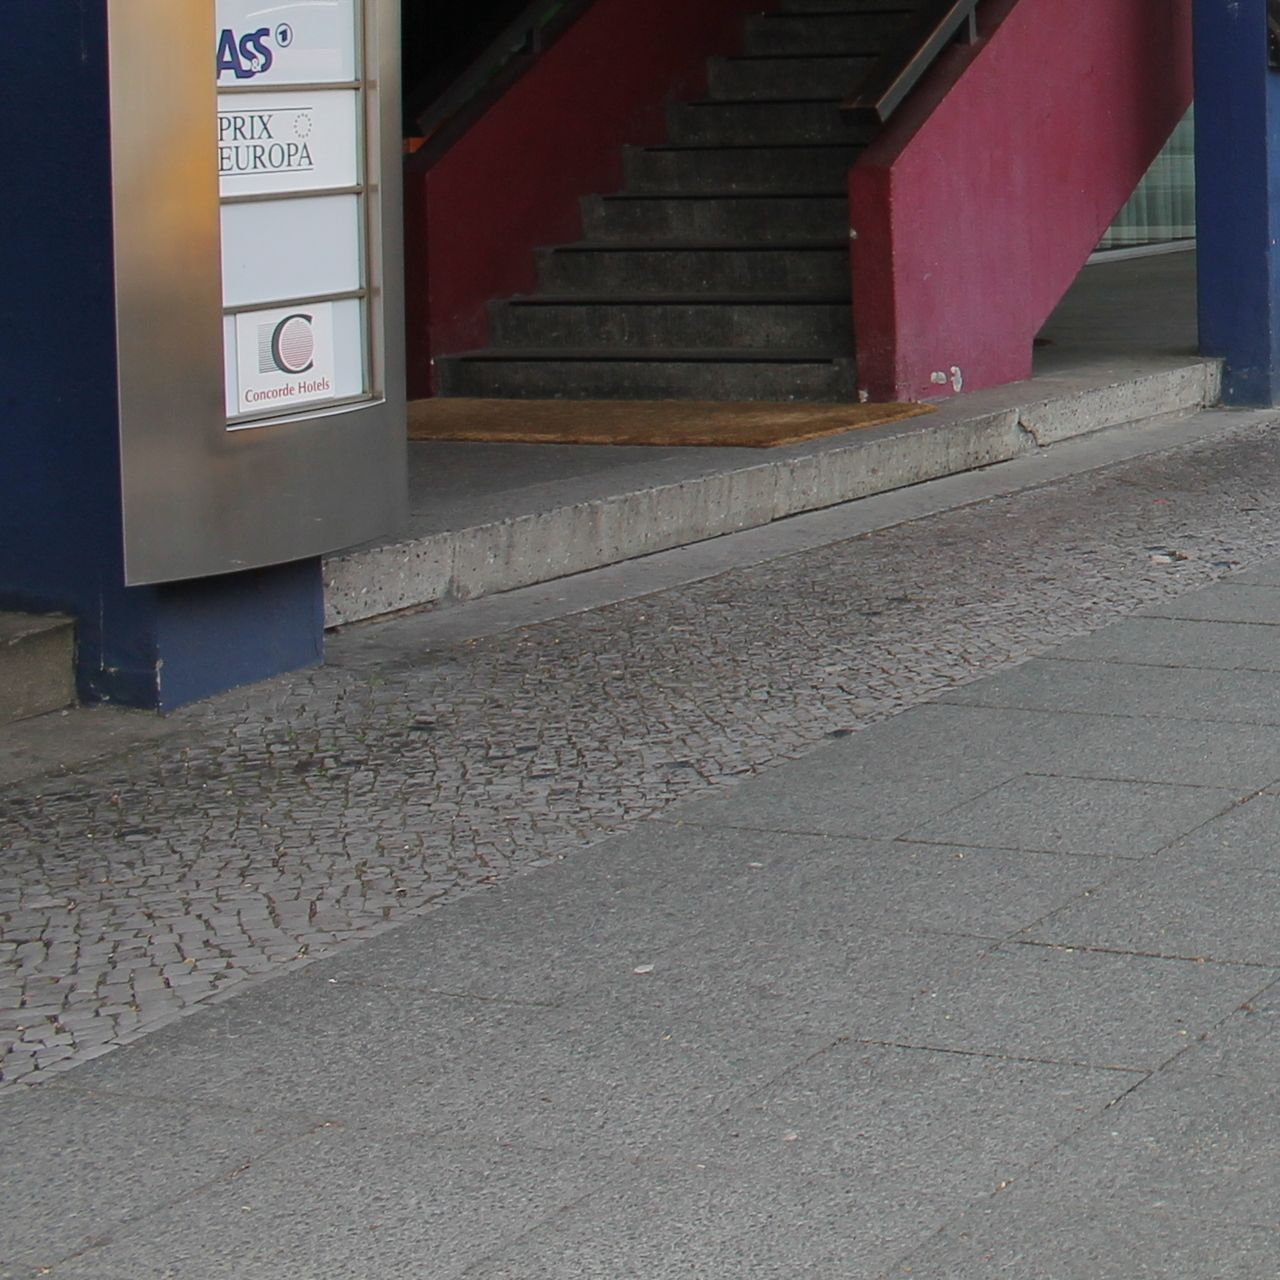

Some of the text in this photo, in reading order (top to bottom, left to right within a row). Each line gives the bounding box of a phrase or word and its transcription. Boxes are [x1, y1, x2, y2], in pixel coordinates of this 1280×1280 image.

[218, 114, 274, 142] PRIX
[218, 142, 315, 171] EUROPA
[245, 377, 331, 403] Concorde Hotels
